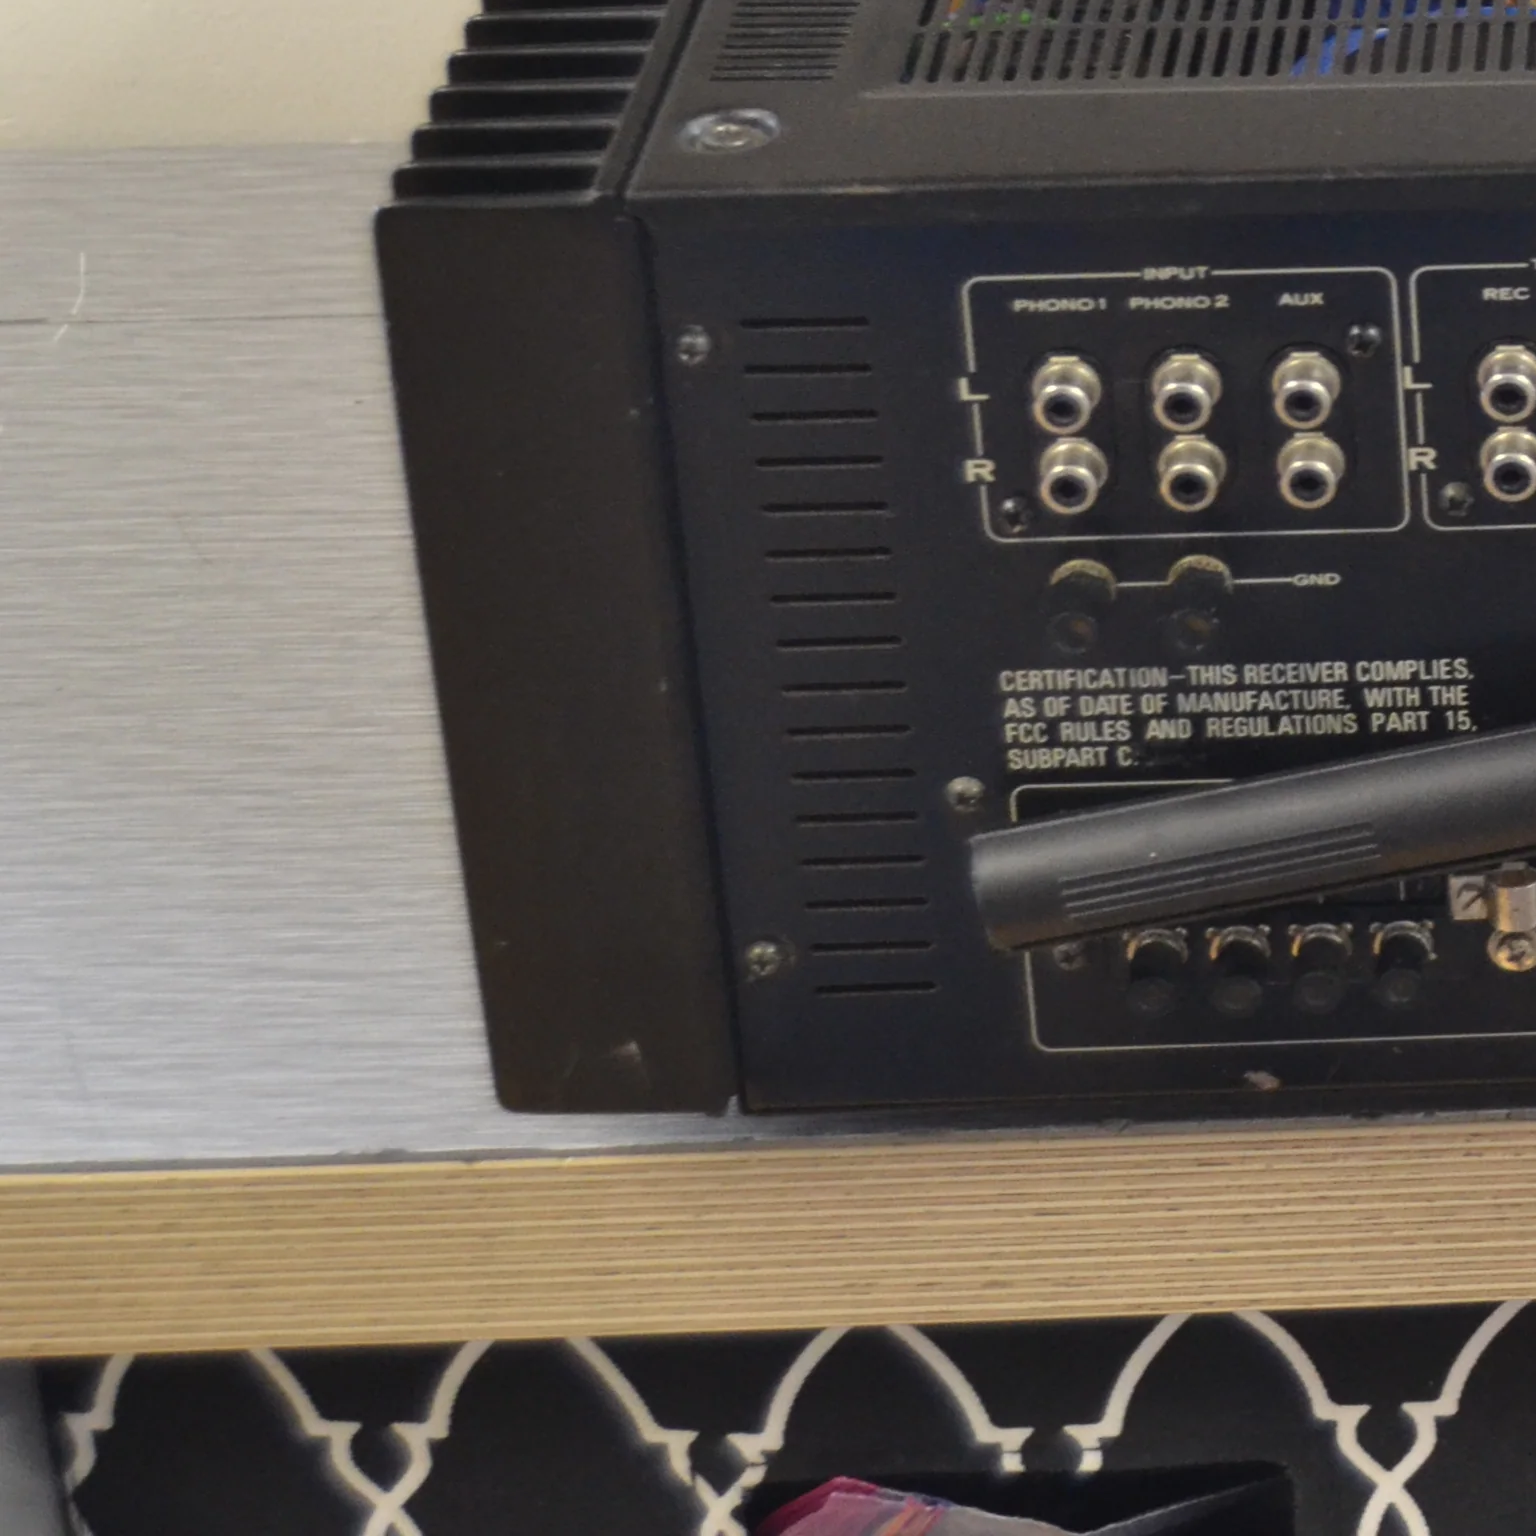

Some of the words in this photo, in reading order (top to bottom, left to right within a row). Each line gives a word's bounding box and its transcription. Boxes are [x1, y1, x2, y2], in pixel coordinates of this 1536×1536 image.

[1143, 266, 1208, 280] INPUT
[1013, 298, 1094, 313] PHONO
[1098, 297, 1107, 311] 1
[1129, 295, 1206, 311] PHONO
[1212, 294, 1230, 309] 2
[1278, 292, 1325, 307] AUX
[1482, 286, 1530, 301] REC
[1403, 364, 1433, 389] L
[958, 377, 989, 402] L
[964, 458, 996, 482] R
[1408, 446, 1437, 471] R
[1292, 572, 1342, 586] GND
[1244, 661, 1348, 685] RECEIVER
[1004, 697, 1037, 719] AS
[1043, 696, 1071, 717] OF
[1079, 694, 1133, 716] DATE
[1140, 693, 1169, 715] OF
[1363, 687, 1421, 708] WITH
[1428, 686, 1470, 707] THE
[1005, 723, 1048, 744] FCC
[1060, 720, 1131, 742] RULES
[1144, 717, 1193, 740] AND
[1206, 713, 1358, 738] REGULATIONS
[1371, 711, 1429, 732] PART
[1007, 747, 1108, 770] SUBPART
[1116, 745, 1139, 767] C.
